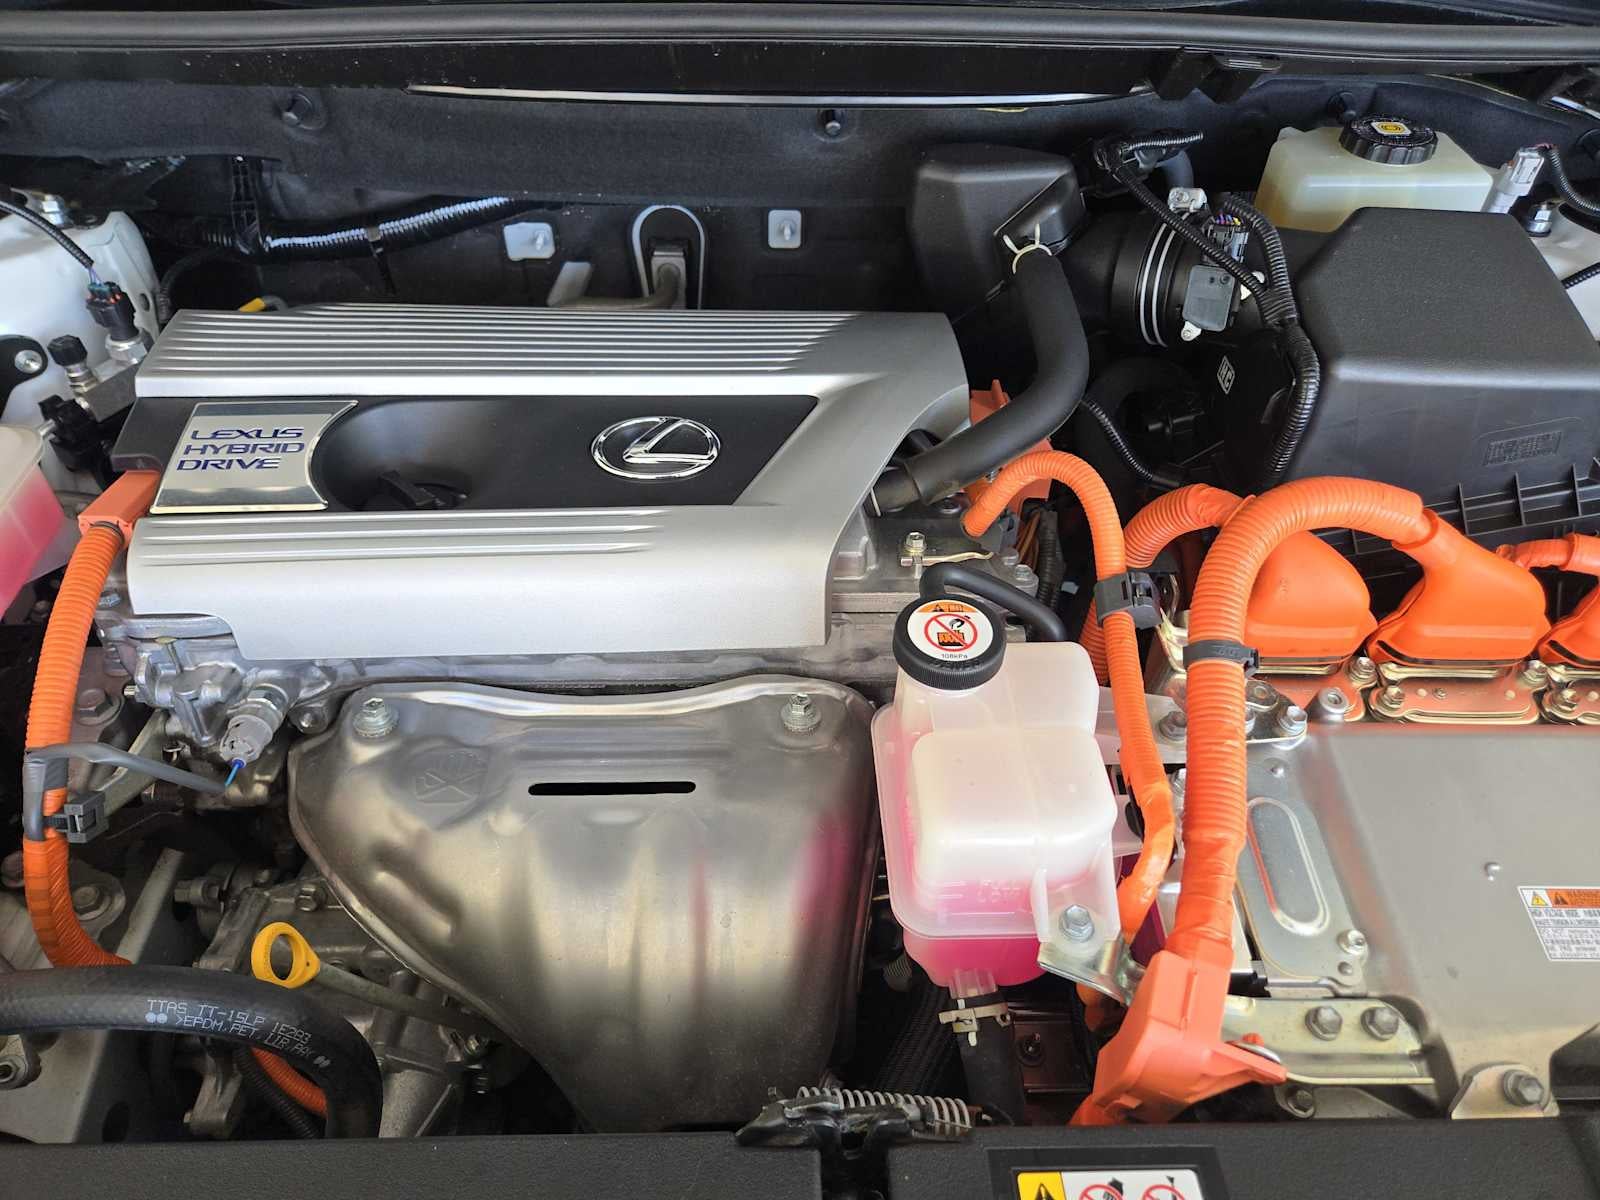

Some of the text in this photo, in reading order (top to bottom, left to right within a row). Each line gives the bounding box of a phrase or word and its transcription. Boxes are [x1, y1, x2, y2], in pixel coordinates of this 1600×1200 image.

[191, 428, 304, 440] LEXUS
[184, 442, 304, 455] HYBRID
[177, 457, 281, 471] DRIVE
[147, 999, 188, 1014] TTAS
